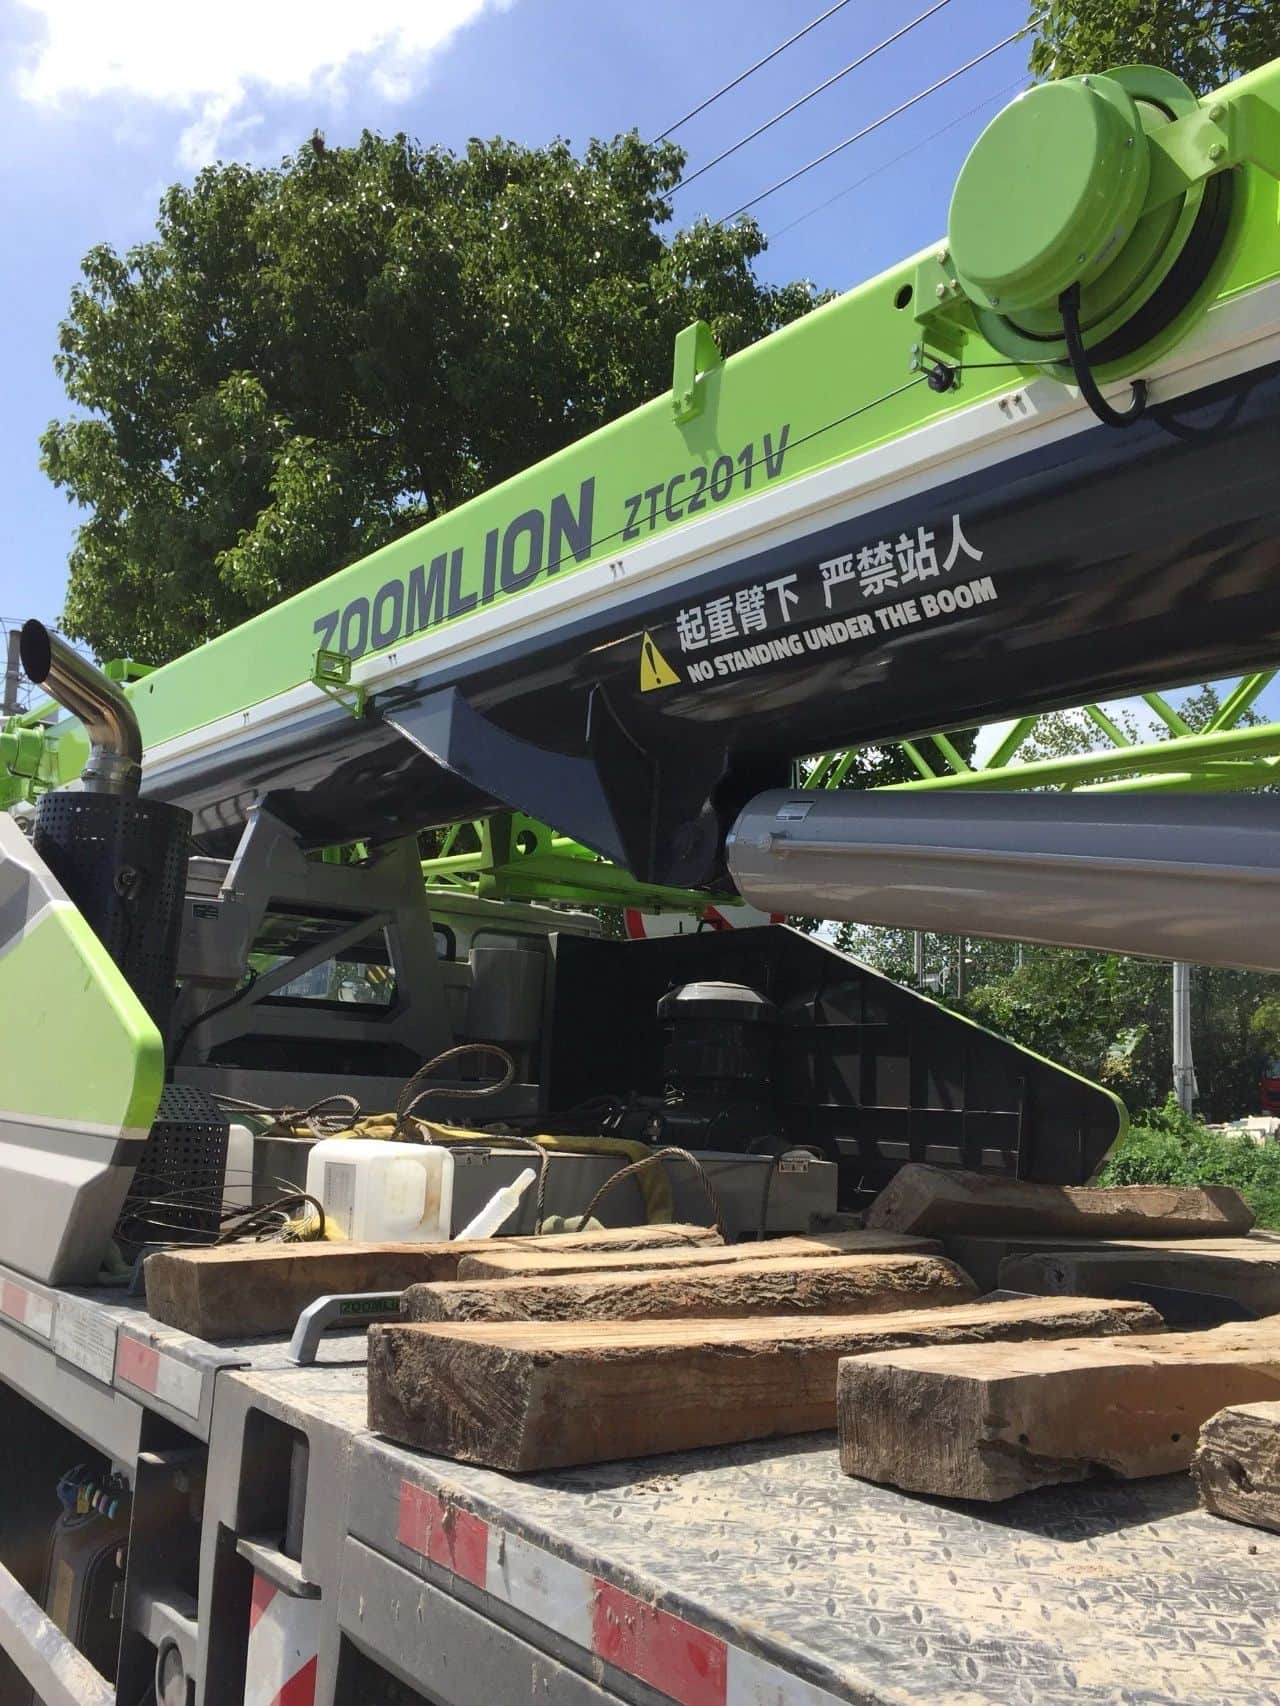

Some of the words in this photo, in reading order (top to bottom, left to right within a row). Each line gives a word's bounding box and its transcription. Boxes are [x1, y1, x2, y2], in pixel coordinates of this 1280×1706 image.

[314, 476, 596, 671] ZOOMLION
[623, 424, 790, 541] ZTC201V
[676, 573, 799, 653] 起重臂下
[819, 514, 983, 608] 严禁站人
[687, 661, 714, 684] NO
[717, 634, 804, 676] STANDING
[800, 616, 876, 652] UNDER
[875, 598, 922, 628] THE
[921, 576, 998, 619] BOOM
